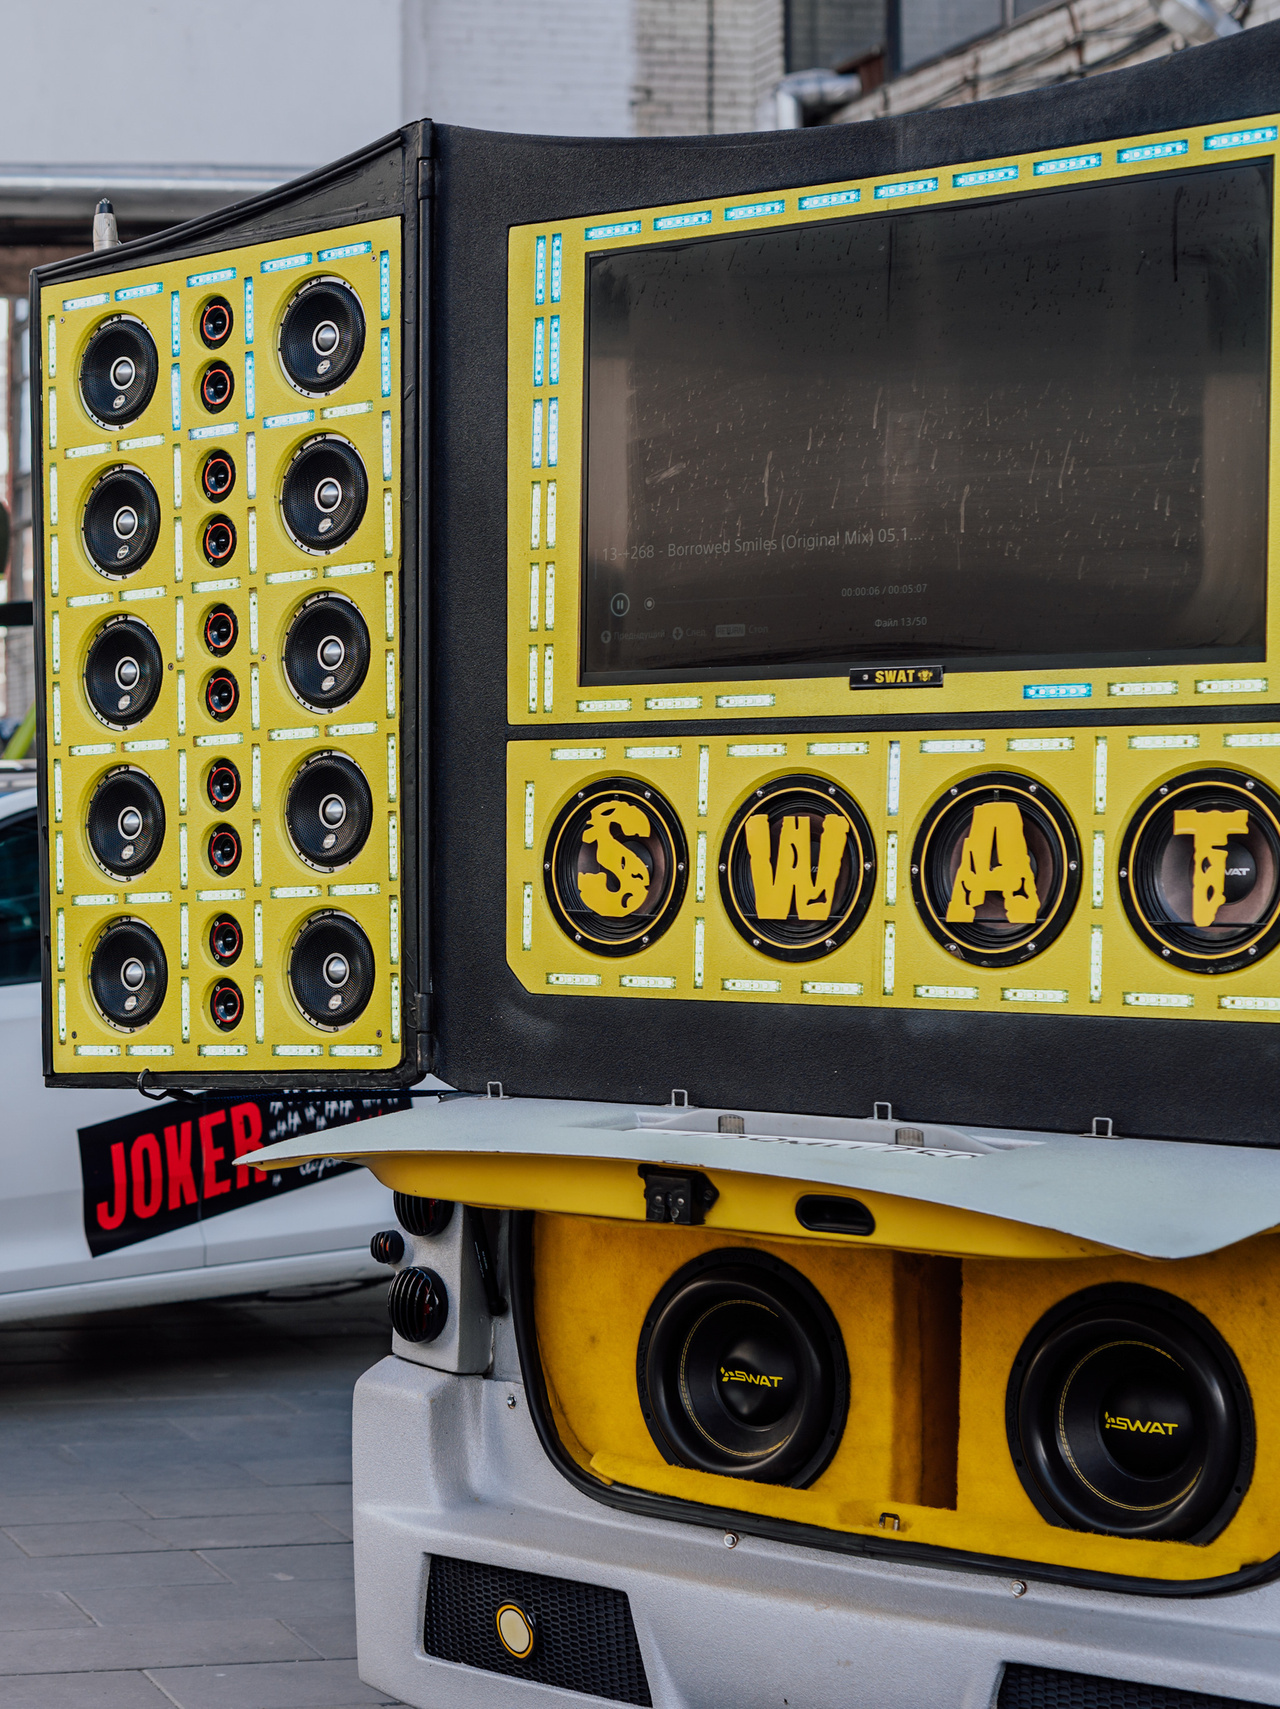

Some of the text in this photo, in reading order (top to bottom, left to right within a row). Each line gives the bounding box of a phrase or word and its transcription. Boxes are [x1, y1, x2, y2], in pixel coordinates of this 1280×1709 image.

[667, 539, 730, 558] Borrowed
[734, 536, 777, 554] Smiles
[781, 530, 839, 552] (Original
[845, 527, 874, 548] Mix)
[841, 586, 880, 598] 00:00:06
[888, 583, 928, 595] 00:05:07
[873, 616, 928, 629] Файл 13/50
[874, 669, 915, 684] SWAT
[96, 1101, 268, 1231] JOKER
[728, 1370, 783, 1388] SWAT
[1108, 1416, 1179, 1435] SWAT
